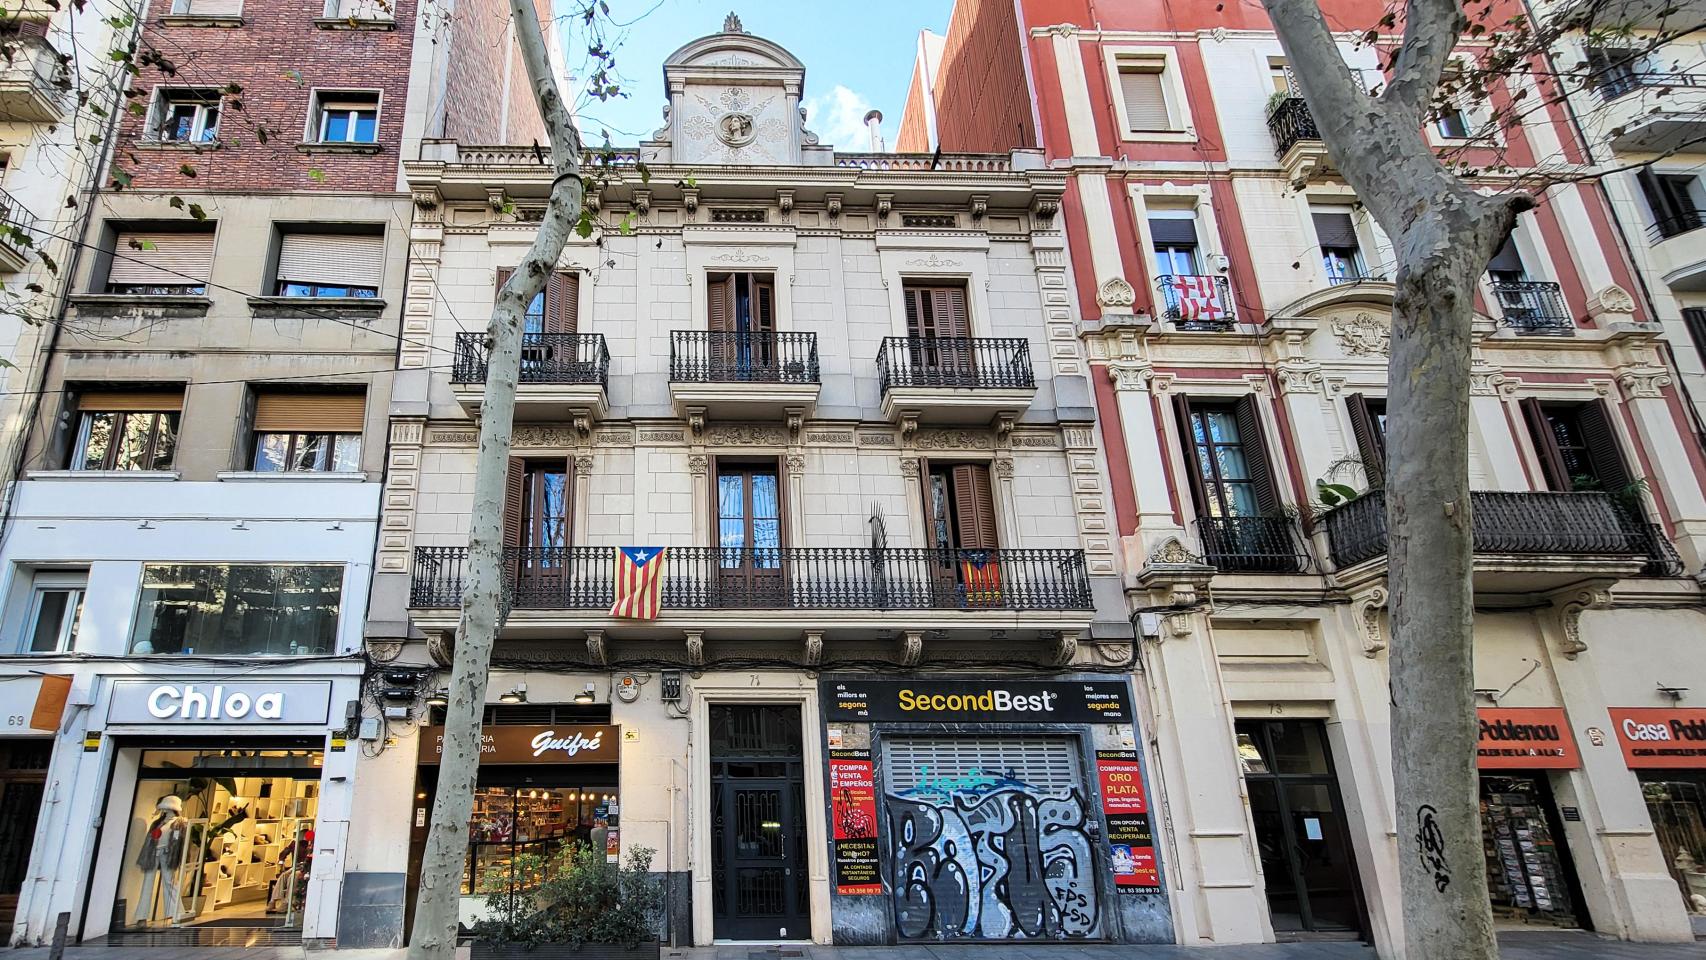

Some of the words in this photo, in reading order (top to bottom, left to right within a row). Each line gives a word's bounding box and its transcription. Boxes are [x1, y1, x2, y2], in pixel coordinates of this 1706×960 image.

[147, 685, 286, 720] Chloa
[838, 702, 867, 710] segona
[1087, 702, 1120, 711] segunda
[1268, 703, 1283, 715] 73
[8, 715, 25, 726] 69
[1479, 719, 1560, 741] Poblenou
[1622, 718, 1671, 741] Casa
[1669, 719, 1706, 741] Pobl
[531, 730, 604, 757] Guifré
[1557, 748, 1566, 756] Z
[1109, 773, 1132, 782] ORO
[840, 779, 873, 787] EMPEÑOS
[1106, 785, 1139, 794] PLATA
